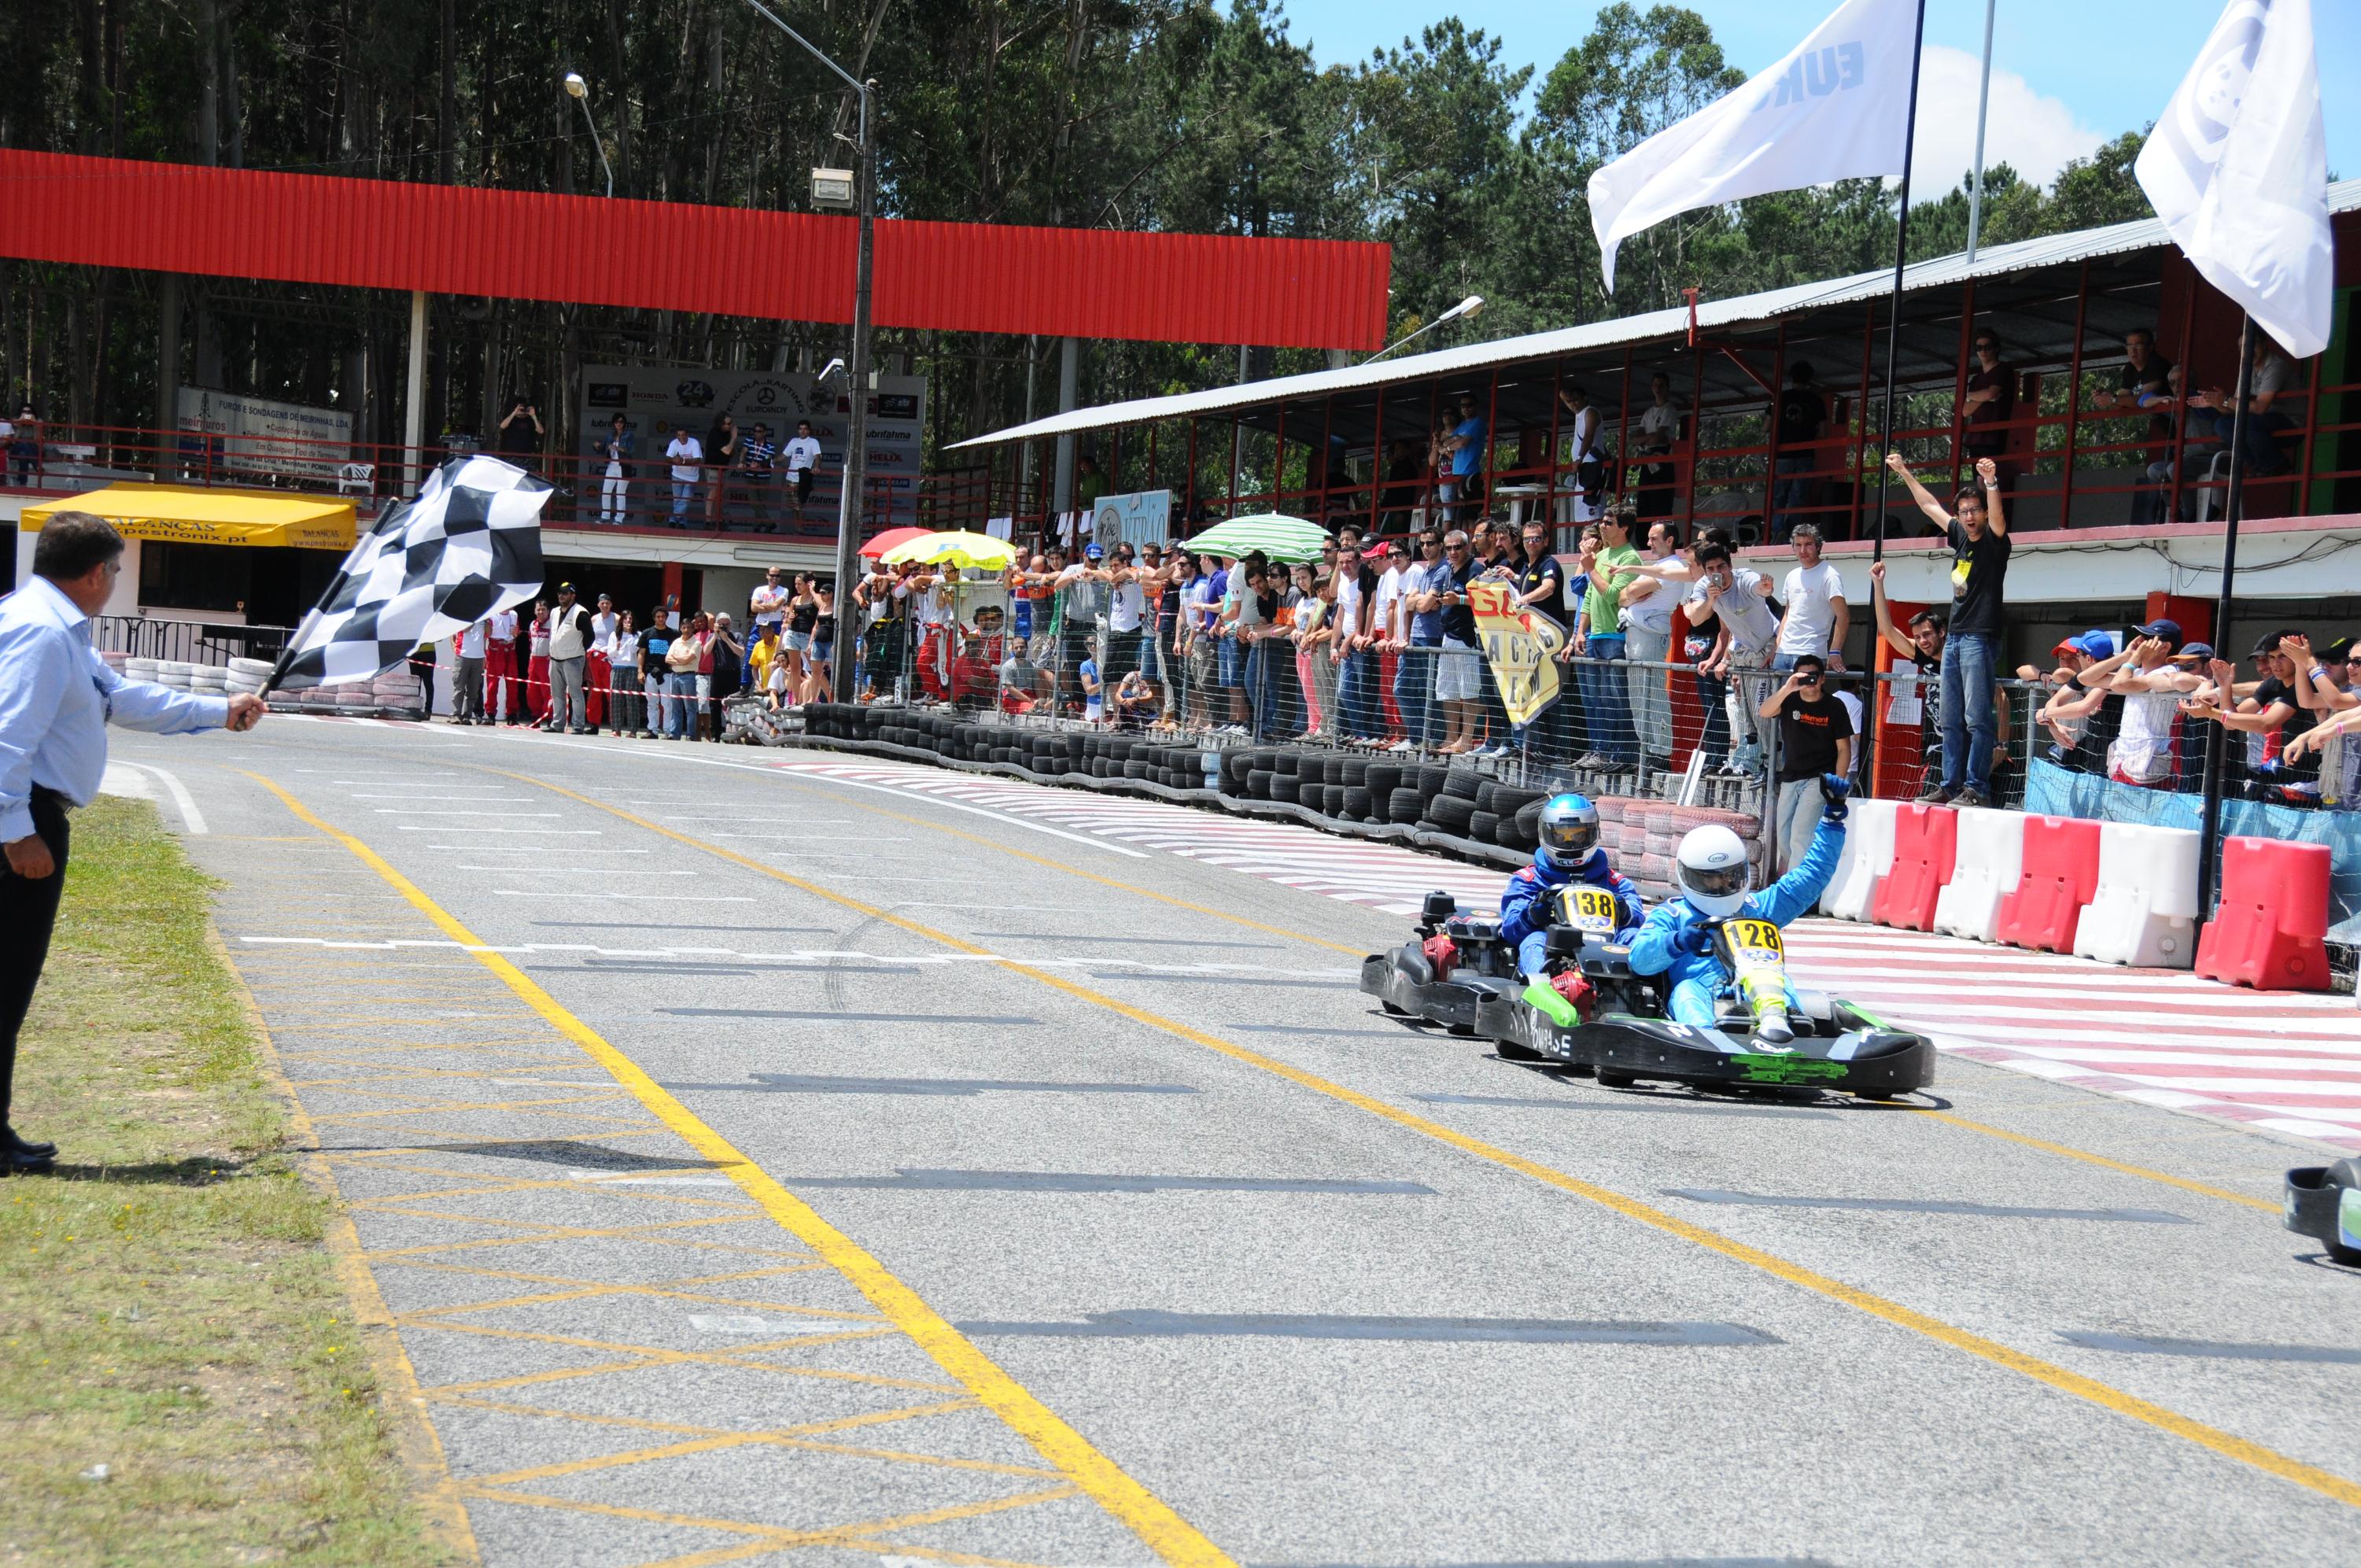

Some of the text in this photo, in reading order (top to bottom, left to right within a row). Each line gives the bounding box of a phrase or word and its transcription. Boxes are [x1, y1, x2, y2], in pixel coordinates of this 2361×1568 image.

[682, 382, 705, 397] 24
[727, 379, 760, 411] ESCOLA
[767, 378, 806, 414] KARTING
[219, 400, 242, 412] FUROS
[243, 405, 247, 414] E
[249, 407, 288, 420] SONDAGENS
[290, 413, 299, 422] DE
[300, 414, 334, 427] MEIRINHAS,
[746, 405, 788, 414] EUROINDY
[866, 430, 911, 440] ubrifatima
[869, 453, 902, 462] HELIX
[311, 461, 334, 472] POMBAL
[111, 517, 216, 533] ALANÇAS
[1758, 680, 1767, 707] loitte.
[1800, 713, 1829, 724] element
[1568, 892, 1612, 917] 138
[1726, 923, 1780, 950] 128
